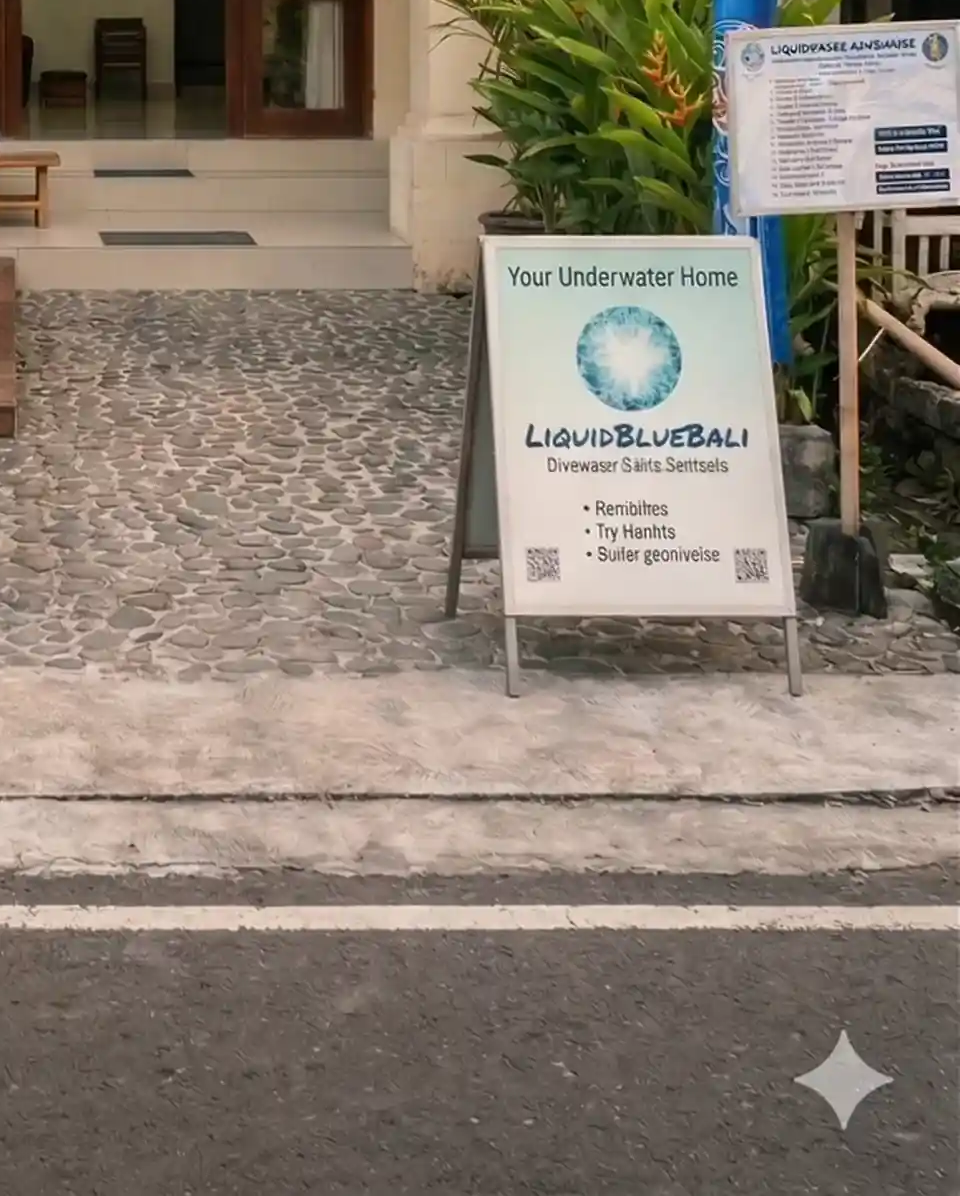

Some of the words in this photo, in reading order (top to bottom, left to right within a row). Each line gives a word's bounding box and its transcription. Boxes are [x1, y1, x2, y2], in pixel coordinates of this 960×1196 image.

[508, 266, 552, 288] Your
[558, 266, 674, 288] Underwater
[680, 267, 739, 288] Home
[596, 523, 618, 543] Try
